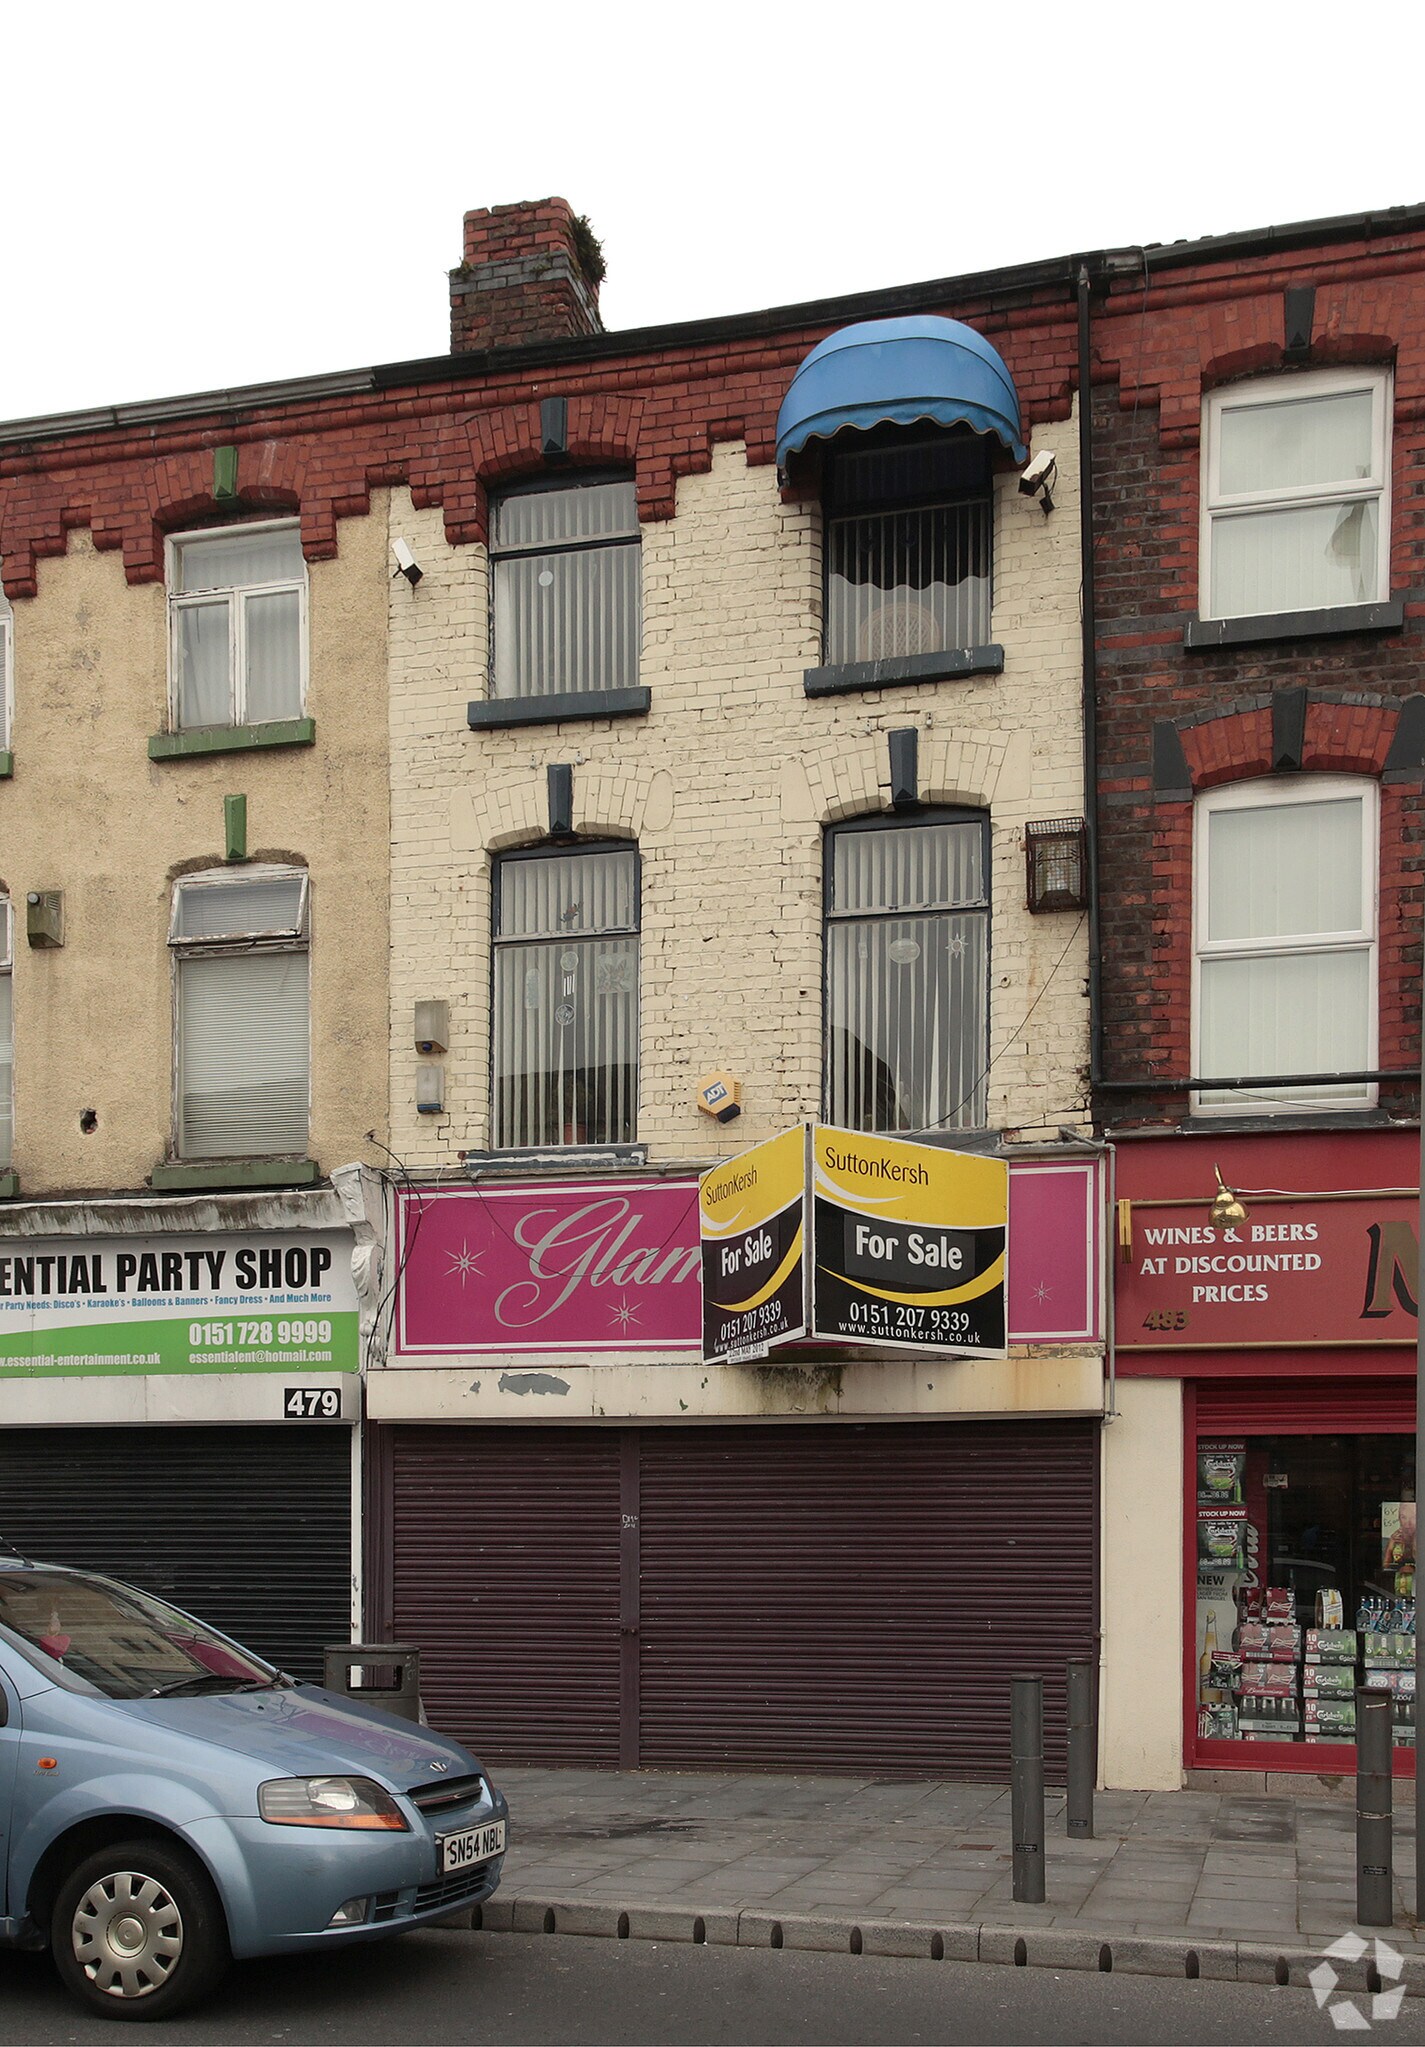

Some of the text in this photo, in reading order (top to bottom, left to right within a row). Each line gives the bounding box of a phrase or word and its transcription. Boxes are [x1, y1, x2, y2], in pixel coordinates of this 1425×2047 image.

[707, 1084, 724, 1102] ADT
[825, 1147, 929, 1186] SuttonKersh
[706, 1164, 758, 1206] SuttonKersh
[1144, 1223, 1319, 1245] WINES & BEERS
[721, 1229, 773, 1277] For Sale
[856, 1224, 963, 1271] For Sale
[0, 1247, 332, 1296] ENTIAL PARTY SHOP
[1140, 1253, 1322, 1275] AT DISCOUNTED
[5, 1301, 25, 1311] Party
[26, 1300, 52, 1309] Needs:
[53, 1299, 81, 1309] Disco's
[87, 1298, 126, 1308] Karaoke's
[131, 1297, 166, 1307] Balloons
[168, 1298, 174, 1306] &
[175, 1297, 209, 1306] Banners
[215, 1296, 238, 1305] Fancy
[239, 1295, 263, 1304] Dress
[269, 1294, 285, 1303] And
[286, 1293, 309, 1303] Much
[310, 1293, 332, 1302] More
[1192, 1284, 1269, 1303] PRICES
[720, 1300, 782, 1342] 0151 207 9339
[850, 1302, 970, 1332] 0151 207 9339
[1142, 1309, 1191, 1331] 483
[189, 1320, 332, 1346] 0151 728 9999
[713, 1316, 789, 1354] www.suttonkersh.co.uk
[838, 1322, 981, 1344] www.suttonkersh.co.uk
[189, 1350, 332, 1364] essentialent@hotmail.com
[287, 1390, 339, 1417] 479
[1197, 1575, 1225, 1585] NEW
[1307, 1634, 1317, 1642] 10
[1304, 1669, 1315, 1677] 10
[1306, 1703, 1316, 1711] 10
[449, 1827, 501, 1865] SN54 NBL
